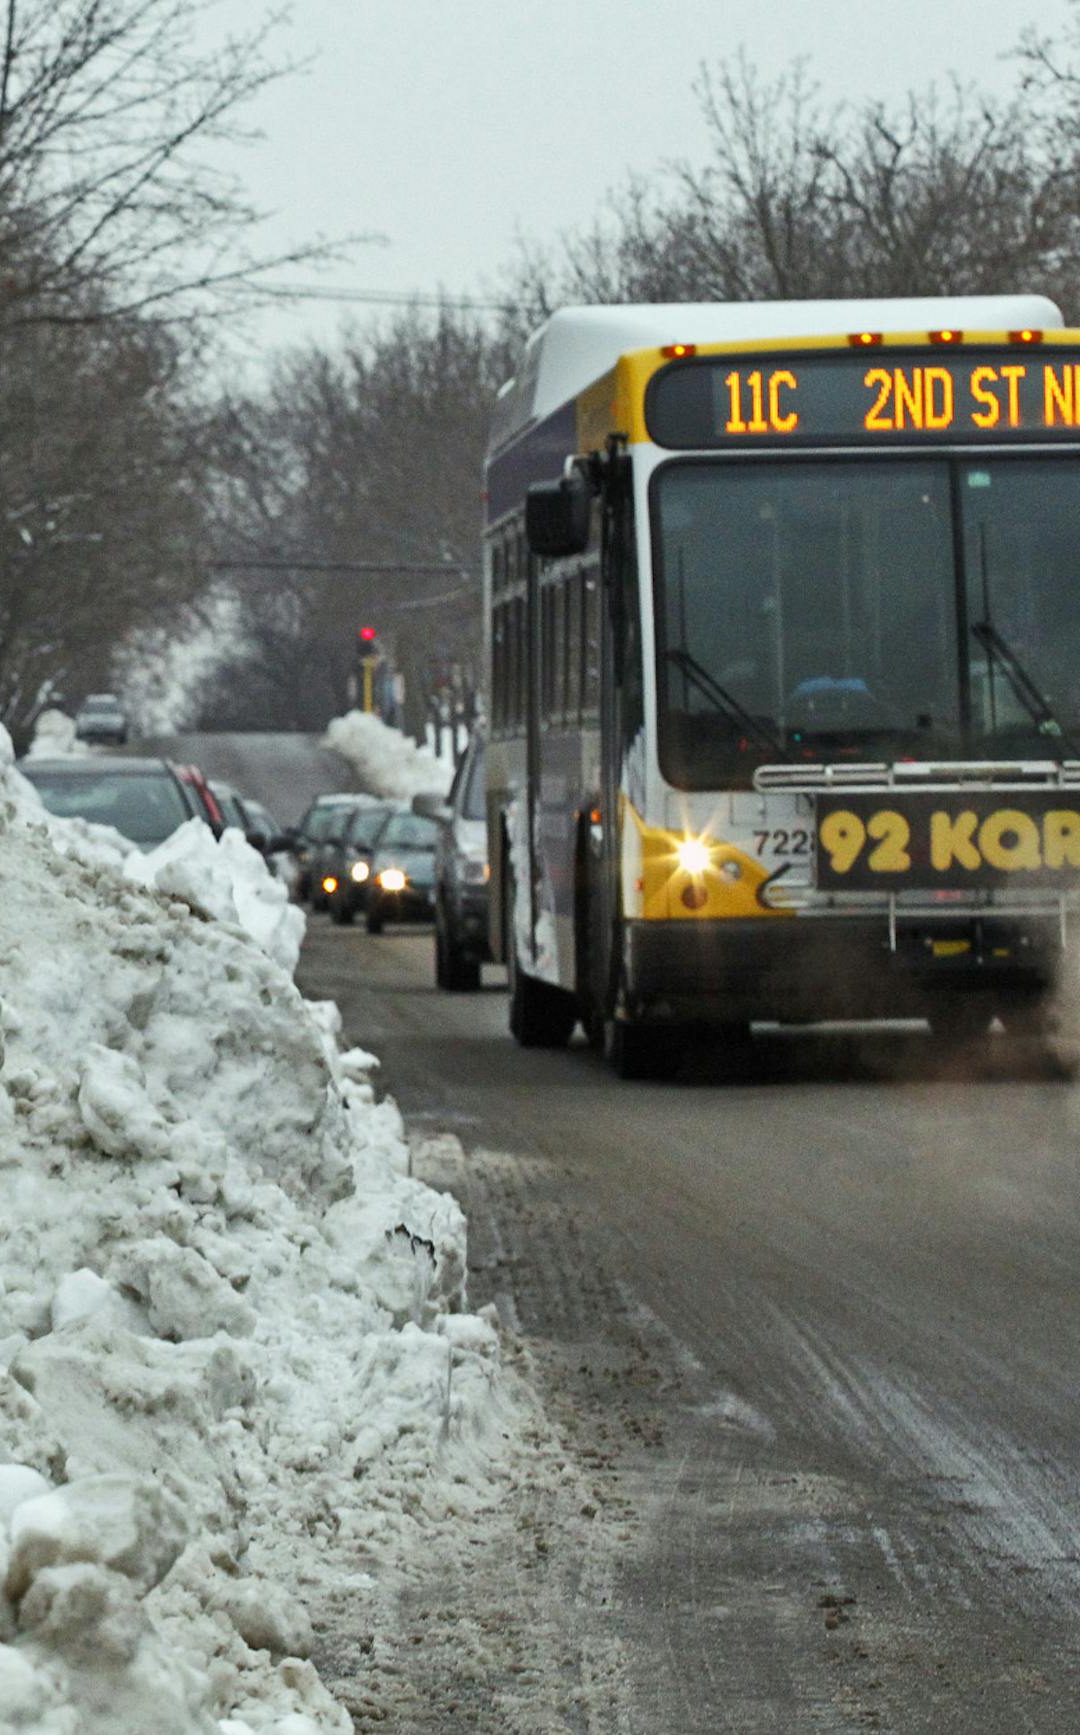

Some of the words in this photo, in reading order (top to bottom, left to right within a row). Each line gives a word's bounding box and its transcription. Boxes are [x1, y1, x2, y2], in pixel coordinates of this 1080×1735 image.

[725, 370, 799, 433] 11C
[863, 366, 954, 431] 2ND
[970, 365, 1027, 429] ST
[820, 810, 911, 873] 92
